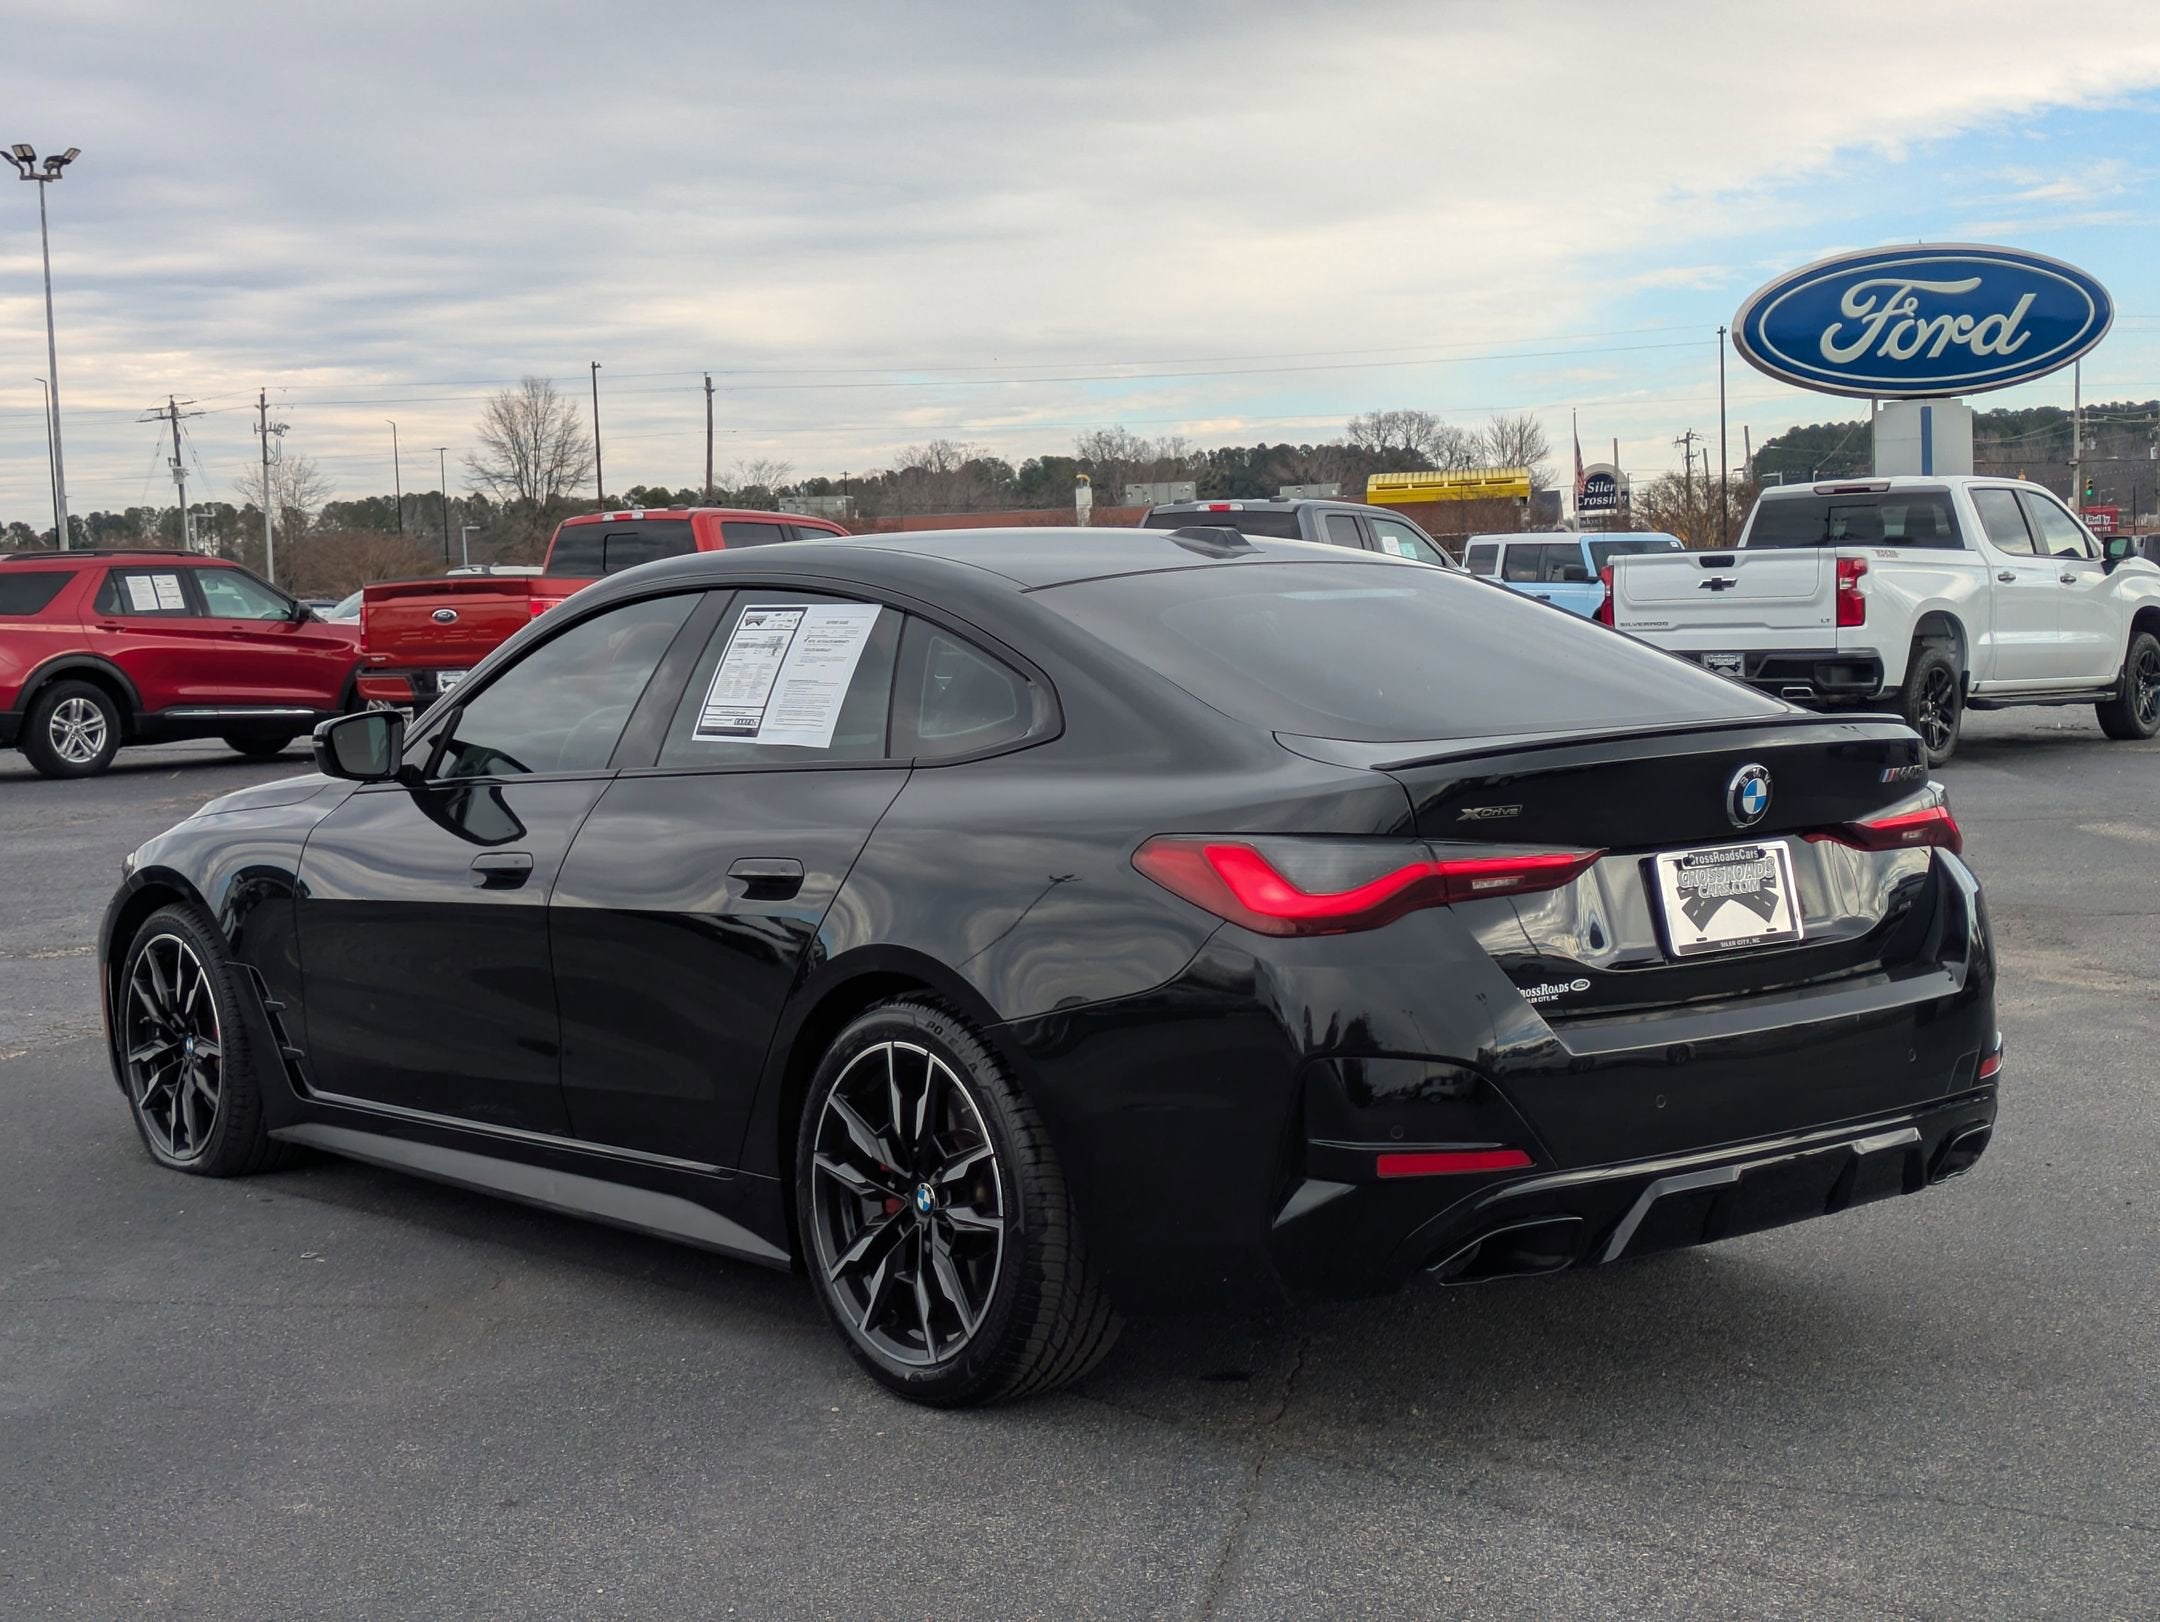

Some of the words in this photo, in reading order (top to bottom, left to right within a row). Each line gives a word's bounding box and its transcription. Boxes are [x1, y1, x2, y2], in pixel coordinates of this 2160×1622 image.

[1820, 277, 2037, 363] Ford
[1587, 481, 1616, 493] Siler
[1740, 768, 1771, 787] BMW
[1690, 848, 1759, 866] CrossRoadsCars
[1677, 857, 1776, 888] CROSSROADS
[1698, 879, 1761, 898] CARS.COM
